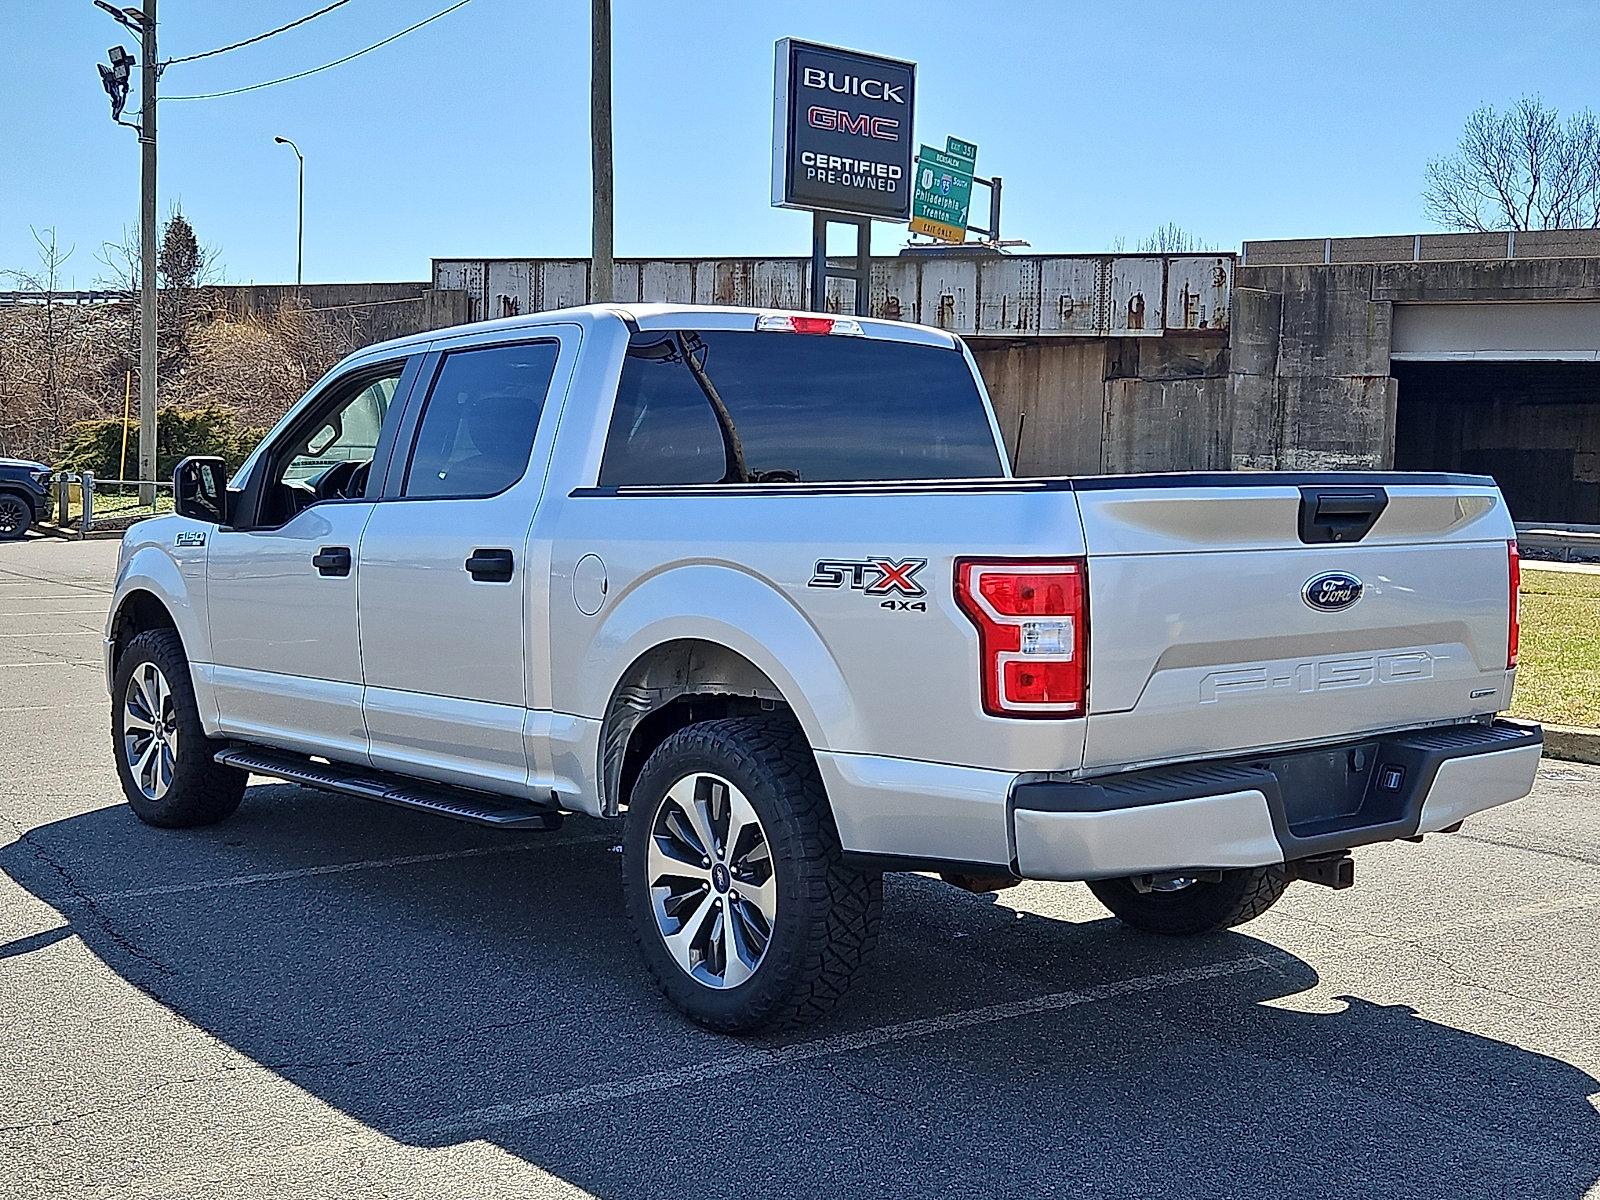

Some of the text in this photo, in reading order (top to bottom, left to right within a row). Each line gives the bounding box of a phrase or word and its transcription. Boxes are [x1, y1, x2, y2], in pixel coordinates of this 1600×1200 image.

[803, 67, 904, 104] BUICK
[808, 105, 899, 141] GMC
[962, 145, 975, 157] 351
[801, 151, 902, 179] CERTIFIED
[807, 167, 896, 192] PRE-OWNED
[942, 181, 950, 191] 95
[915, 188, 959, 211] Philadelphia
[922, 205, 950, 222] Trenton
[923, 223, 952, 238] EXIT ONLY
[807, 556, 928, 598] STX
[1319, 580, 1353, 603] Ford
[1199, 650, 1434, 704] F-150
